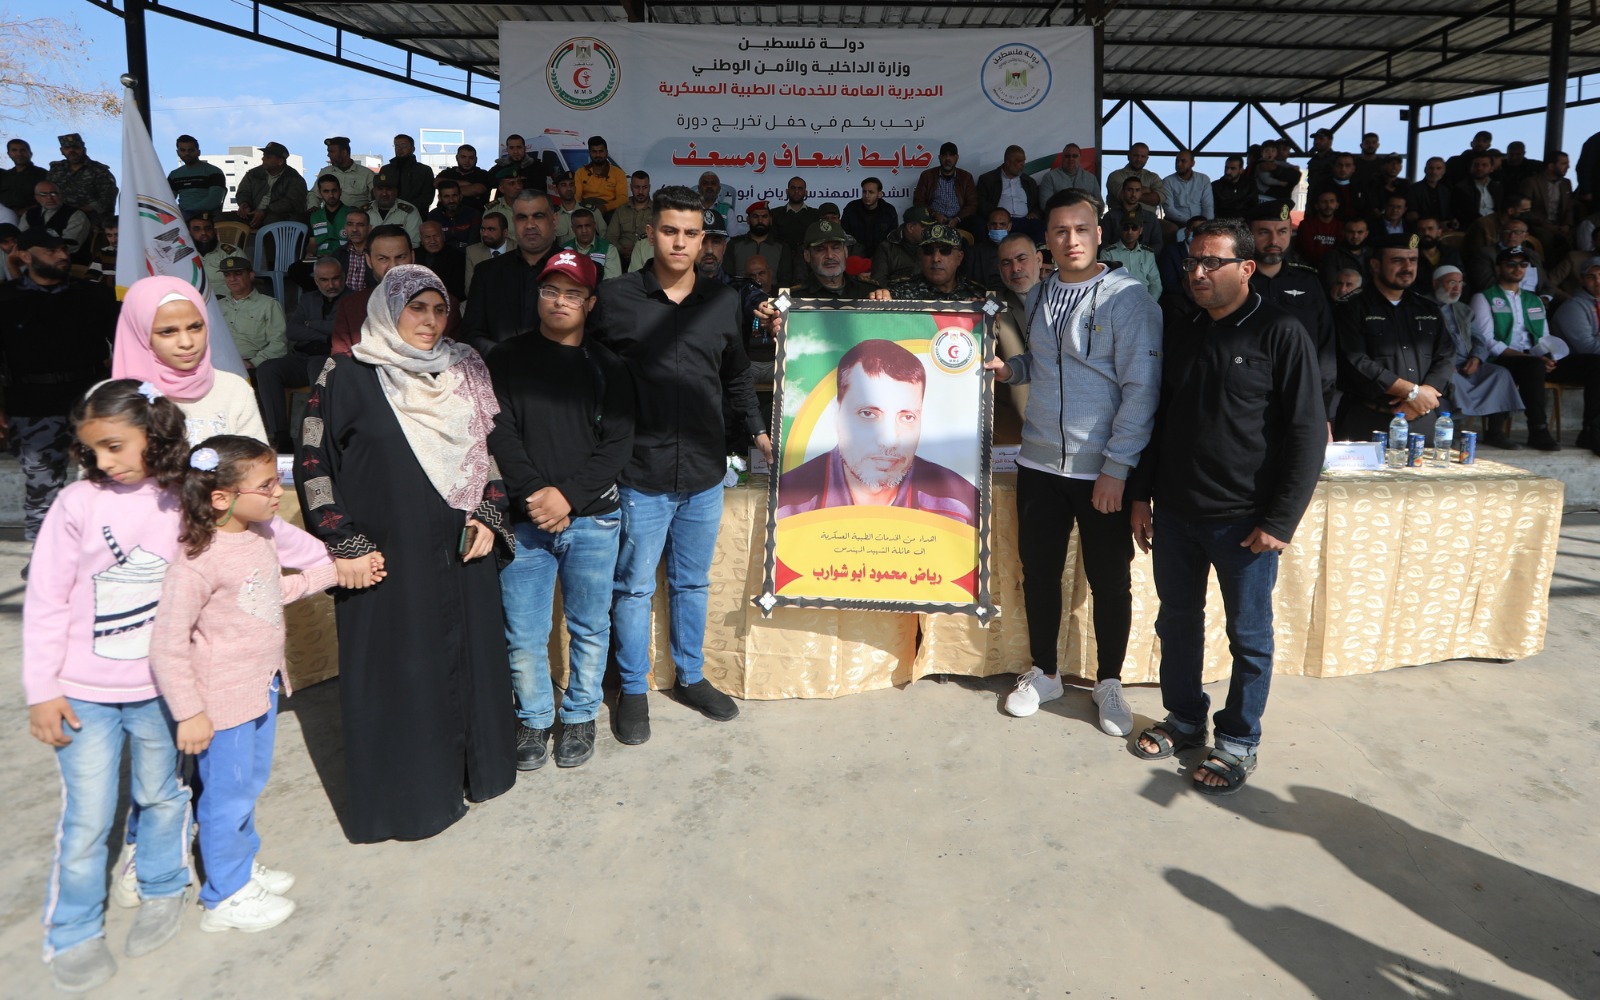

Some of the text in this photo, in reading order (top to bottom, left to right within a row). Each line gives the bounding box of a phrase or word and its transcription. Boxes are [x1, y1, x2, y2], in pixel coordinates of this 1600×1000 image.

[738, 37, 865, 53] دولة فلسطين
[692, 58, 911, 77] وزارة الداخلية والأمن الوطني
[658, 81, 943, 100] المديرية العامة للخدمات الطبية العسكرية
[677, 113, 926, 134] ترحب بكم في حفل تخريج دورة
[672, 142, 933, 176] ضابط إسعاف ومسعف
[738, 185, 754, 201] أبو
[820, 531, 849, 540] العسكرية
[851, 532, 873, 541] الطبية
[902, 535, 916, 544] من
[812, 563, 943, 585] رياض محمود أبو شوارب
